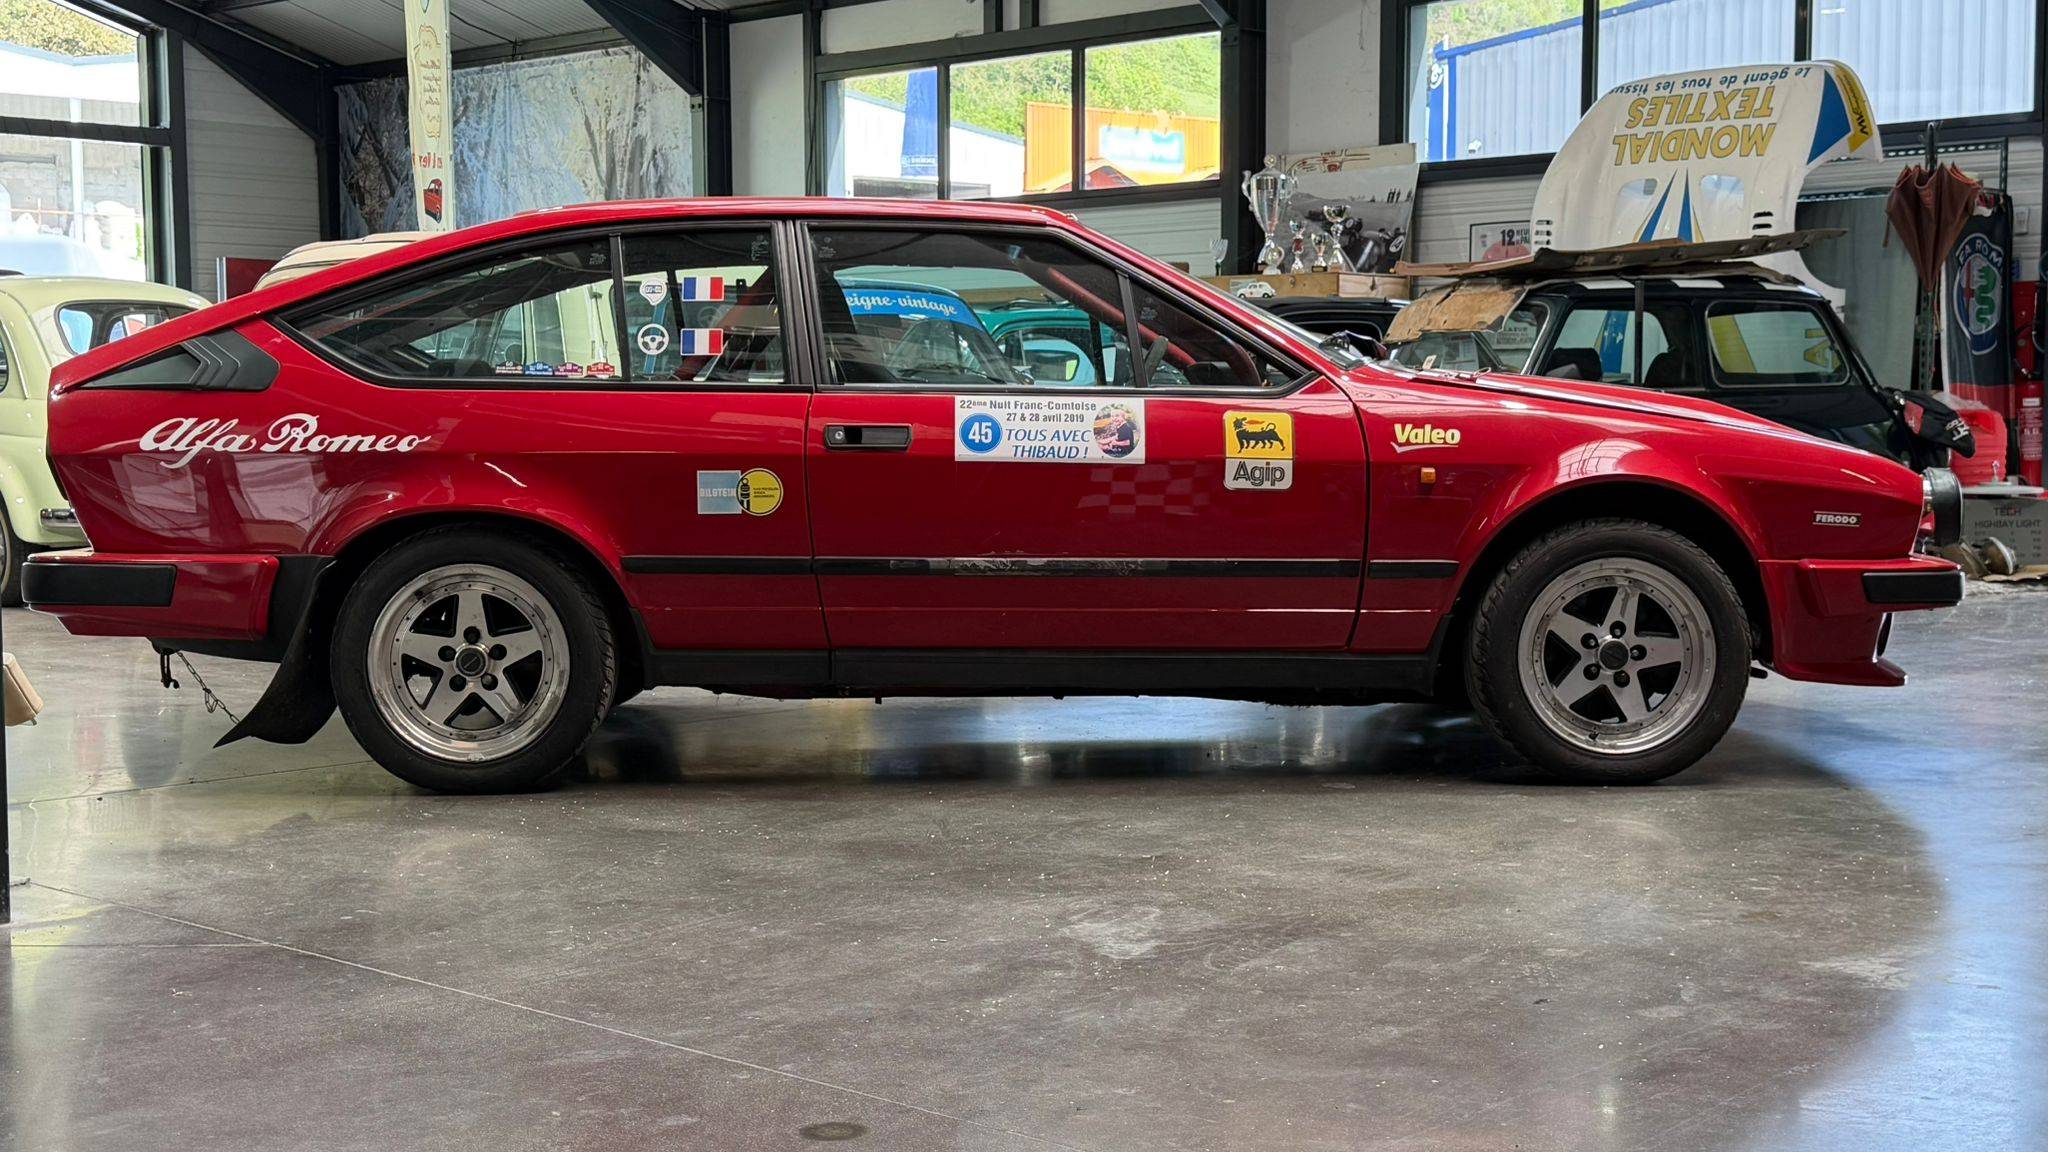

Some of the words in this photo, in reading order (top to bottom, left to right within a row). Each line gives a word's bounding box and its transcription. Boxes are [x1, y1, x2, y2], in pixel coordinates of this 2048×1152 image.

[1743, 67, 1789, 87] géant
[1795, 67, 1811, 78] Le
[1655, 80, 1674, 93] les
[1682, 77, 1712, 89] tous
[1719, 75, 1737, 86] de
[1625, 86, 1775, 129] TEXTILES
[1613, 123, 1776, 166] MONDIAL
[1500, 229, 1515, 247] 12
[990, 400, 1011, 409] Nuit
[1014, 400, 1096, 411] Franc-Comtoise
[1006, 413, 1018, 421] 27
[1020, 413, 1026, 421] &
[1029, 413, 1040, 422] 28
[1042, 413, 1062, 422] avril
[1064, 414, 1085, 423] 2019
[968, 422, 993, 443] 45
[1005, 429, 1046, 442] TOUS
[1050, 429, 1092, 443] AVEC
[1394, 423, 1461, 444] Valeo
[139, 417, 257, 469] Alfa
[260, 413, 431, 452] Romeo
[1012, 445, 1080, 459] THIBAUD
[1233, 461, 1286, 487] Agip
[1815, 514, 1857, 523] FERODO
[2015, 519, 2041, 529] LIGHT
